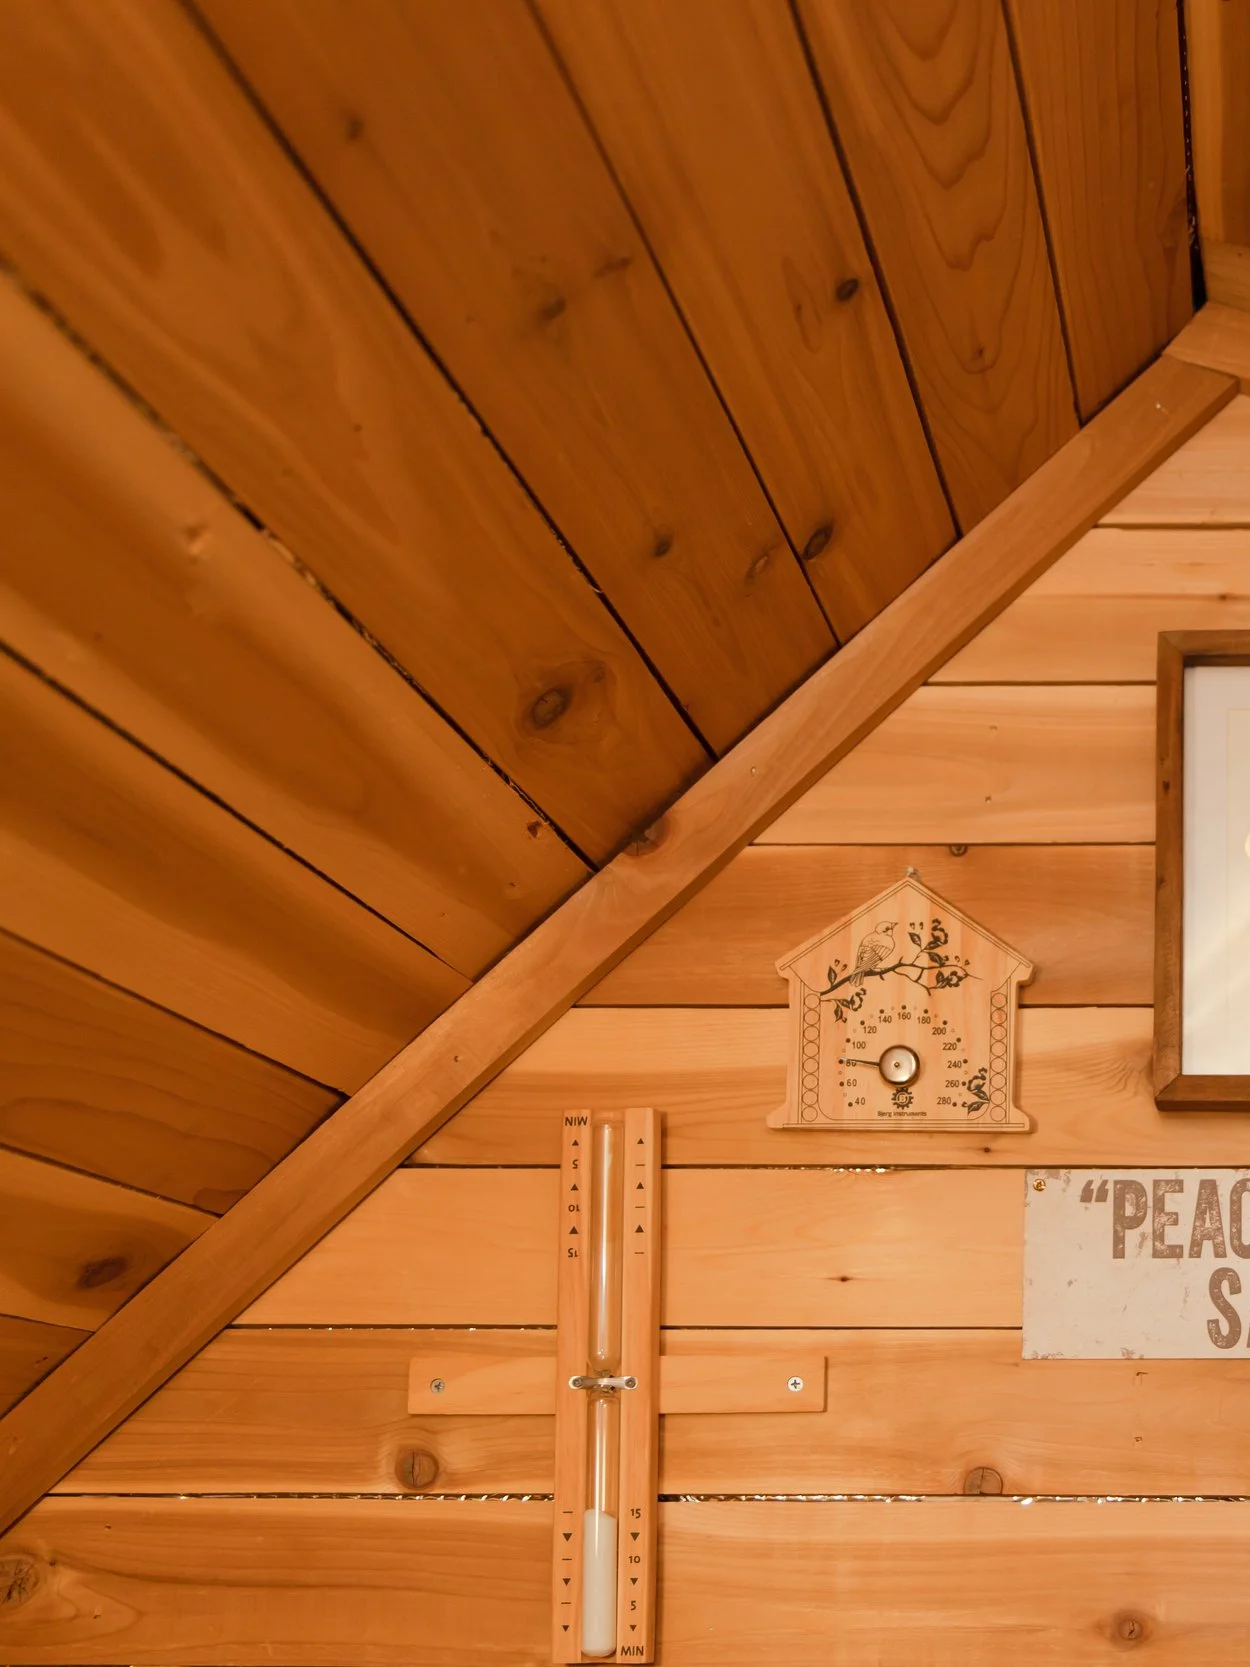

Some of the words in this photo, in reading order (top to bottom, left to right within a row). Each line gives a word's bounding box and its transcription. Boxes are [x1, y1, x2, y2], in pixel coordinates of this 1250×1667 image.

[878, 1015, 892, 1023] 140
[897, 1012, 911, 1021] 160
[917, 1016, 931, 1024] 180
[863, 1026, 877, 1034] 120
[932, 1026, 947, 1035] 200
[852, 1041, 866, 1049] 100
[942, 1042, 957, 1050] 220
[947, 1060, 962, 1069] 240
[846, 1078, 857, 1087] 60
[945, 1079, 960, 1088] 260
[854, 1097, 866, 1105] 40
[936, 1096, 951, 1105] 280
[564, 1116, 588, 1126] MIN
[572, 1159, 578, 1169] 5
[568, 1204, 580, 1212] 10
[567, 1248, 578, 1258] 15
[630, 1508, 641, 1519] 15
[628, 1556, 641, 1564] 10
[630, 1600, 637, 1611] 5
[620, 1646, 645, 1657] MIN
